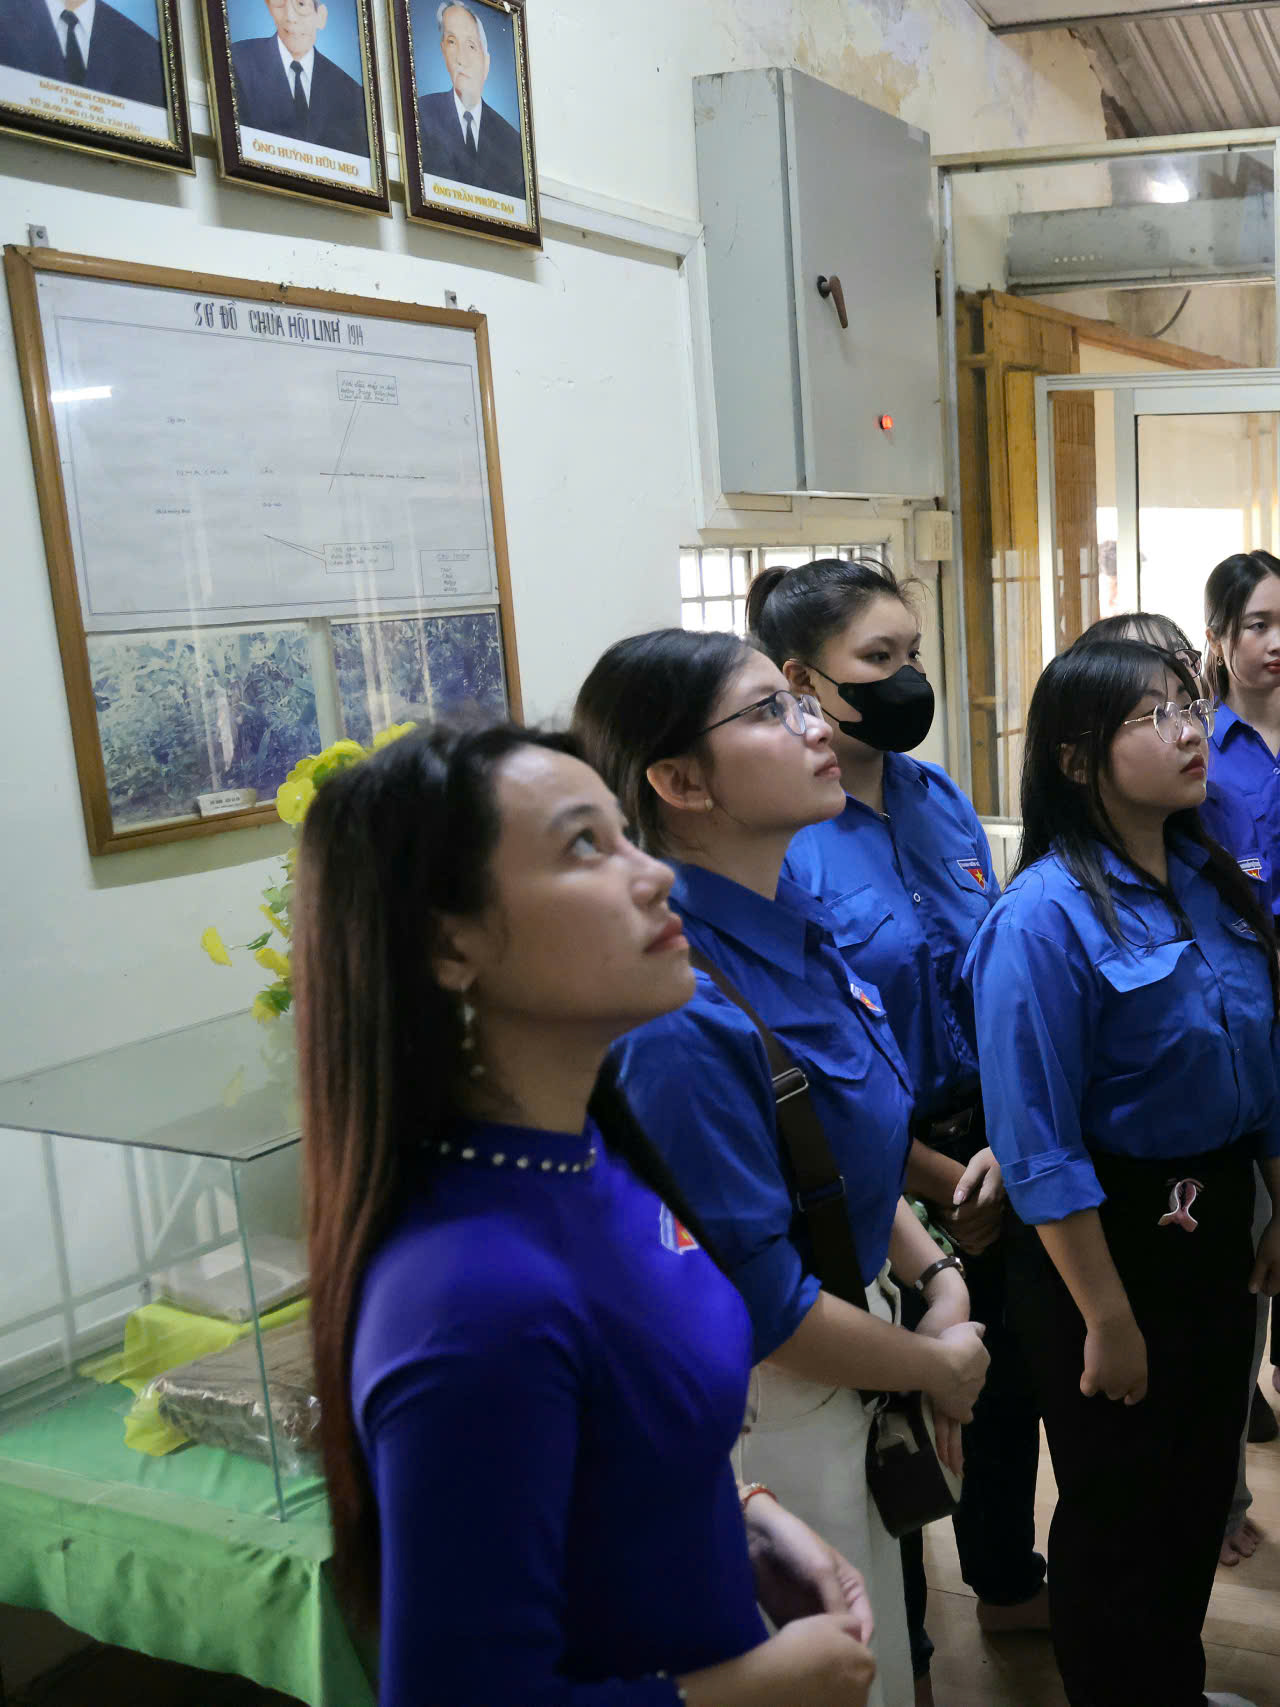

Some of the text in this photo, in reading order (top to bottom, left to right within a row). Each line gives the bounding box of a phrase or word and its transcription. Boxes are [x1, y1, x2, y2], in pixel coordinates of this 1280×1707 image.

[252, 138, 275, 155] ÔNG
[277, 146, 313, 166] HUỲNH
[432, 182, 452, 199] ÔNG
[193, 300, 364, 346] SƠ ĐỒ CHÙA HỘI LINH 1914
